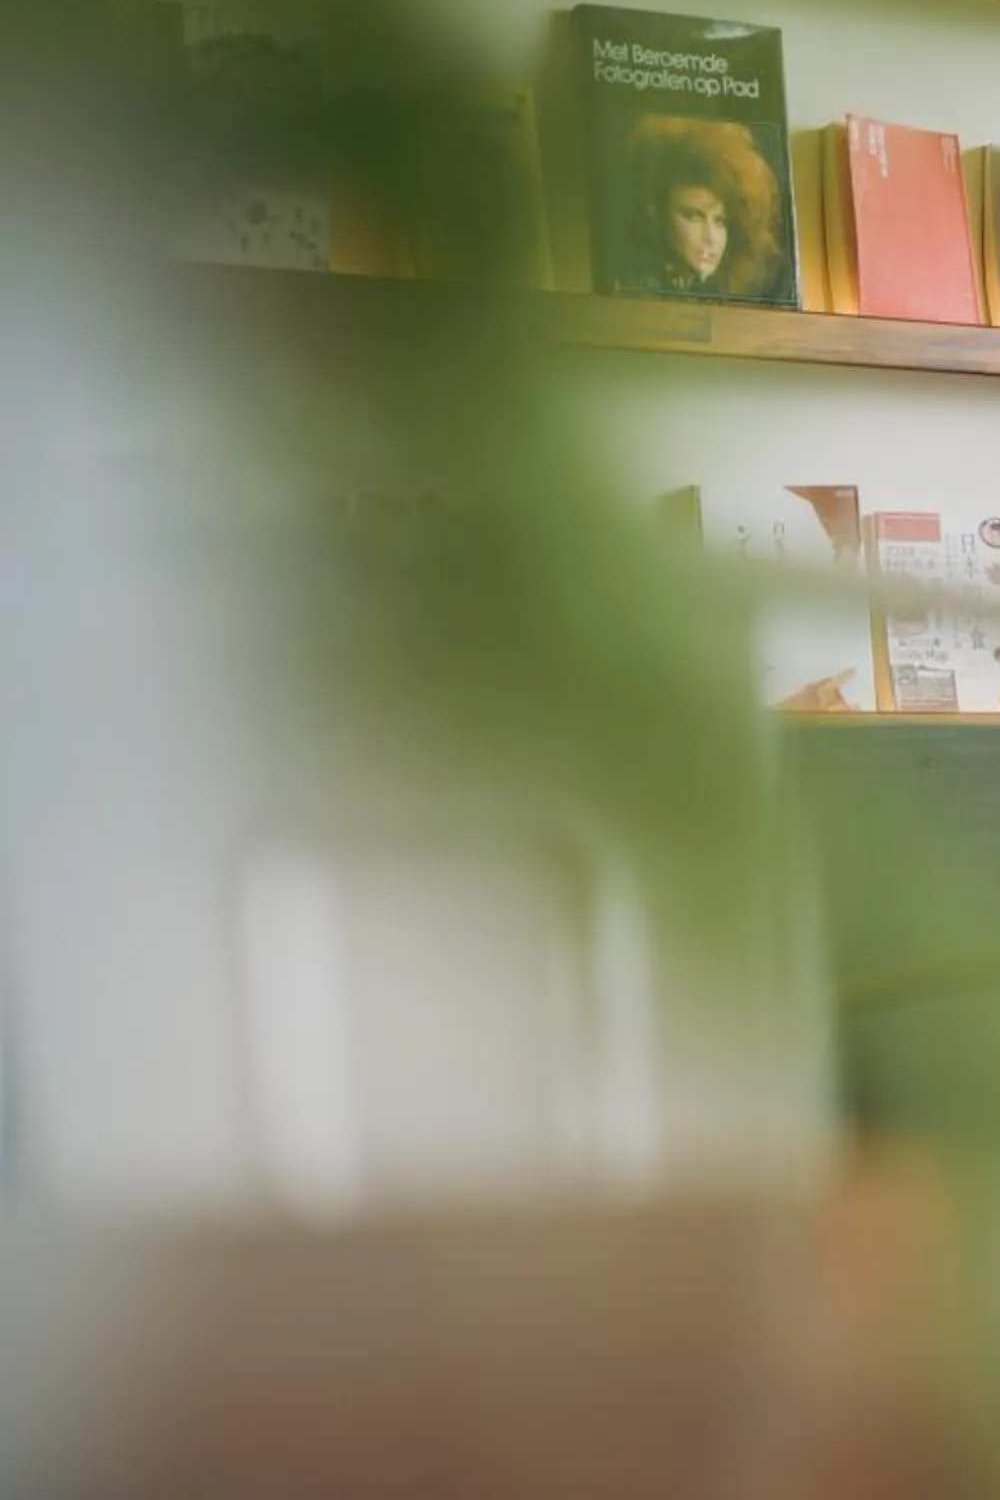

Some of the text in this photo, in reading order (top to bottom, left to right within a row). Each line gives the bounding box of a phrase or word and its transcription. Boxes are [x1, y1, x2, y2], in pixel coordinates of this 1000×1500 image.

[592, 37, 729, 75] Met Beroemde
[593, 60, 760, 99] Fotografen op Pad
